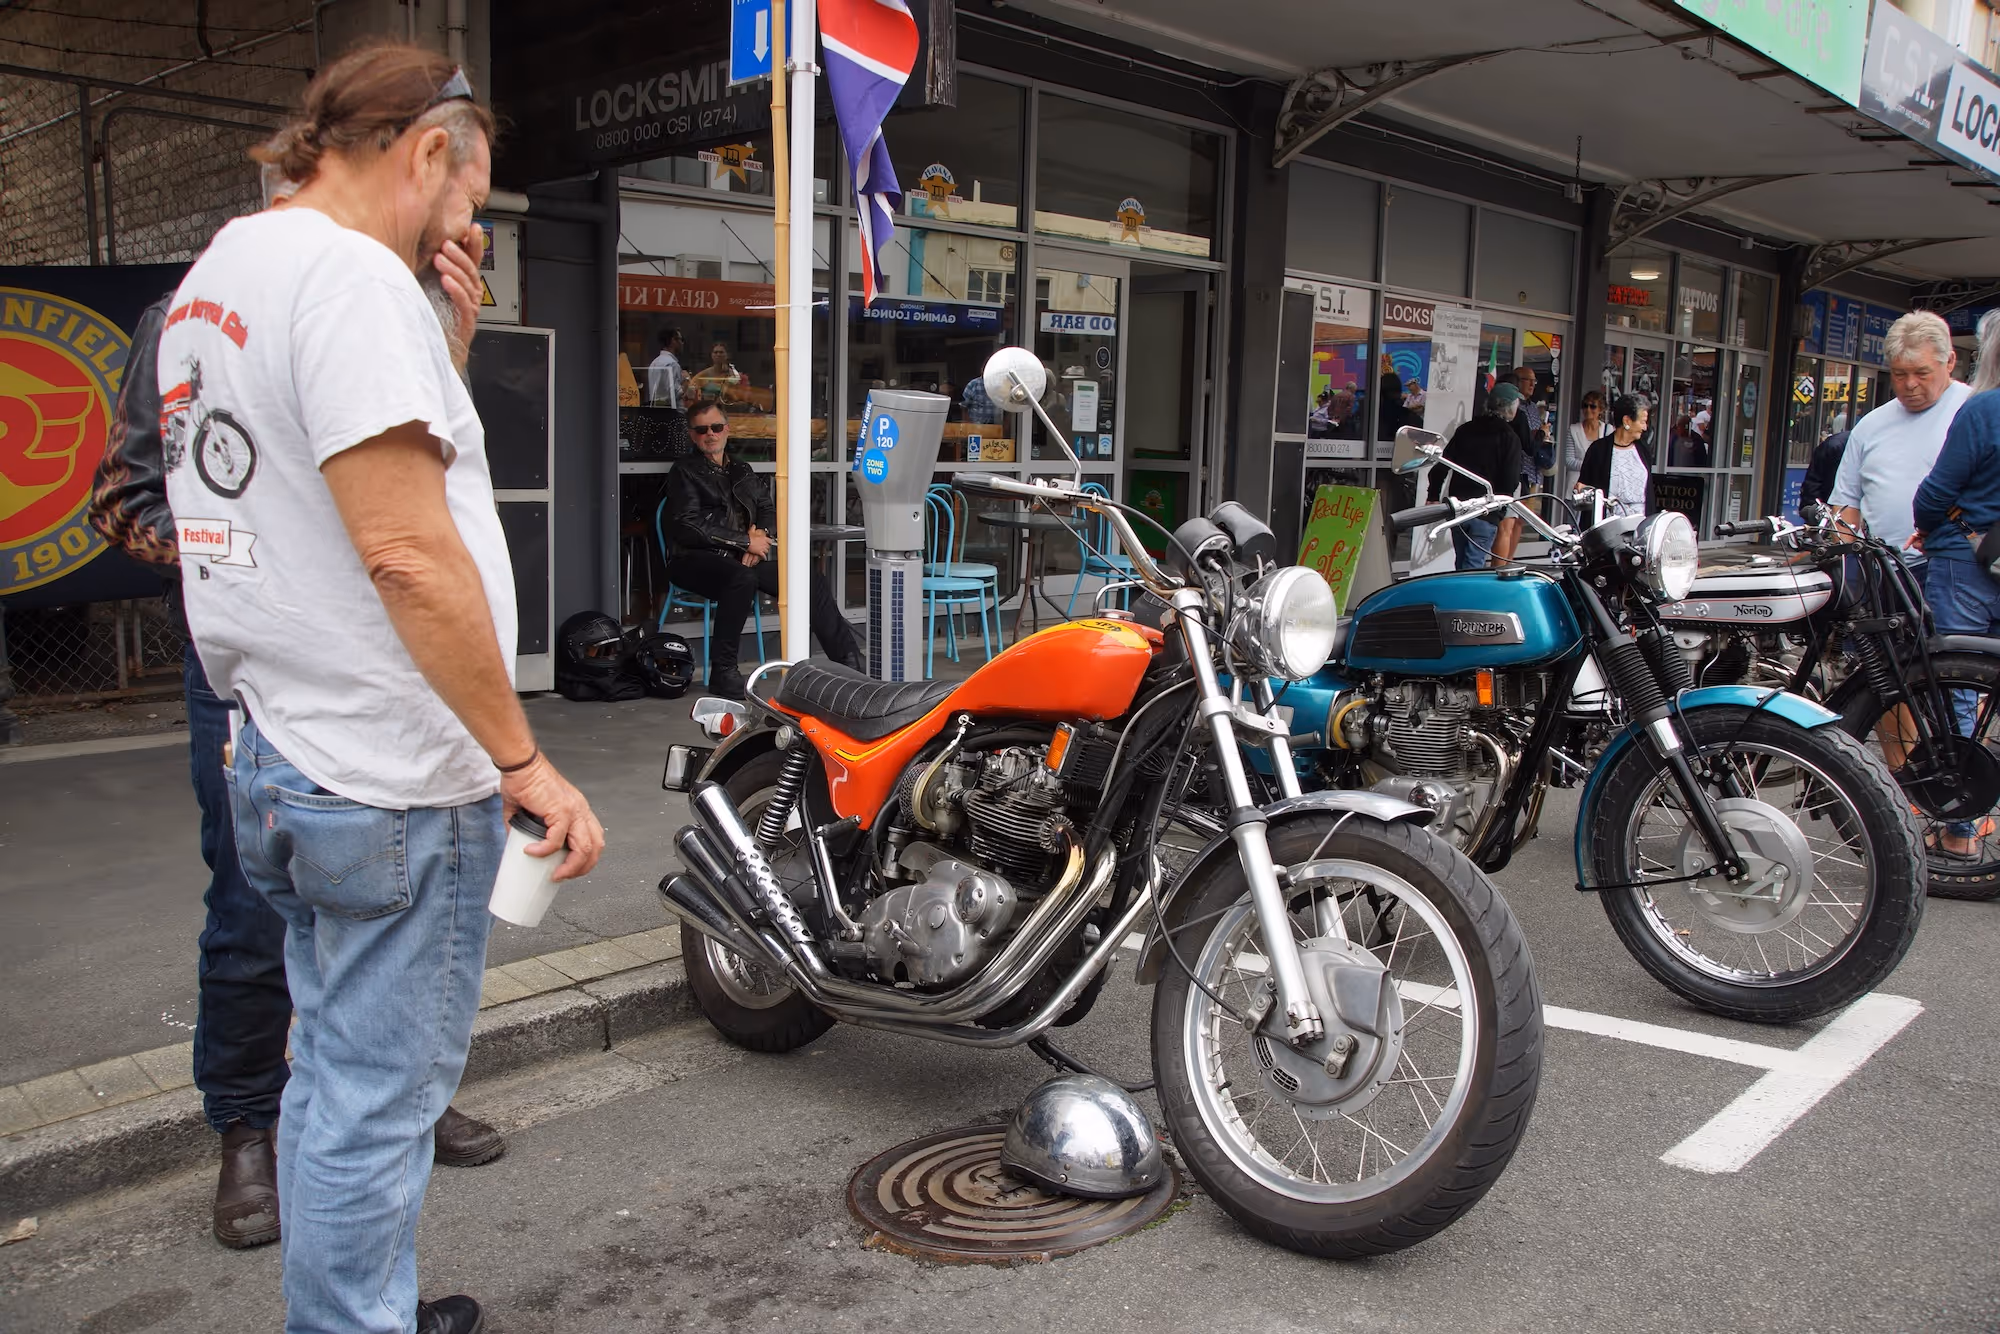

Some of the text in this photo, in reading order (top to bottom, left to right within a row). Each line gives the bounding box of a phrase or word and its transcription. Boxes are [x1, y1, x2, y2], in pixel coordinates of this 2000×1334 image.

[575, 60, 765, 131] LOCKSMIT
[596, 104, 737, 149] 0800 000 CSI (274)
[699, 153, 762, 170] COFFEE WORKS
[924, 165, 952, 182] HAVANA
[1302, 284, 1350, 315] .S.I.
[1680, 287, 1718, 312] TATTOOS
[860, 401, 873, 439] PAY HERE
[879, 417, 890, 435] P
[876, 437, 893, 448] 120
[866, 459, 884, 469] ZONE
[867, 467, 882, 476] TWO
[1655, 484, 1697, 498] ATTOO
[1312, 495, 1365, 528] Red Eye
[1656, 497, 1695, 510] TUDIO
[183, 528, 224, 545] Festival
[1733, 604, 1773, 618] Norton
[1452, 618, 1507, 634] TRIUMPH
